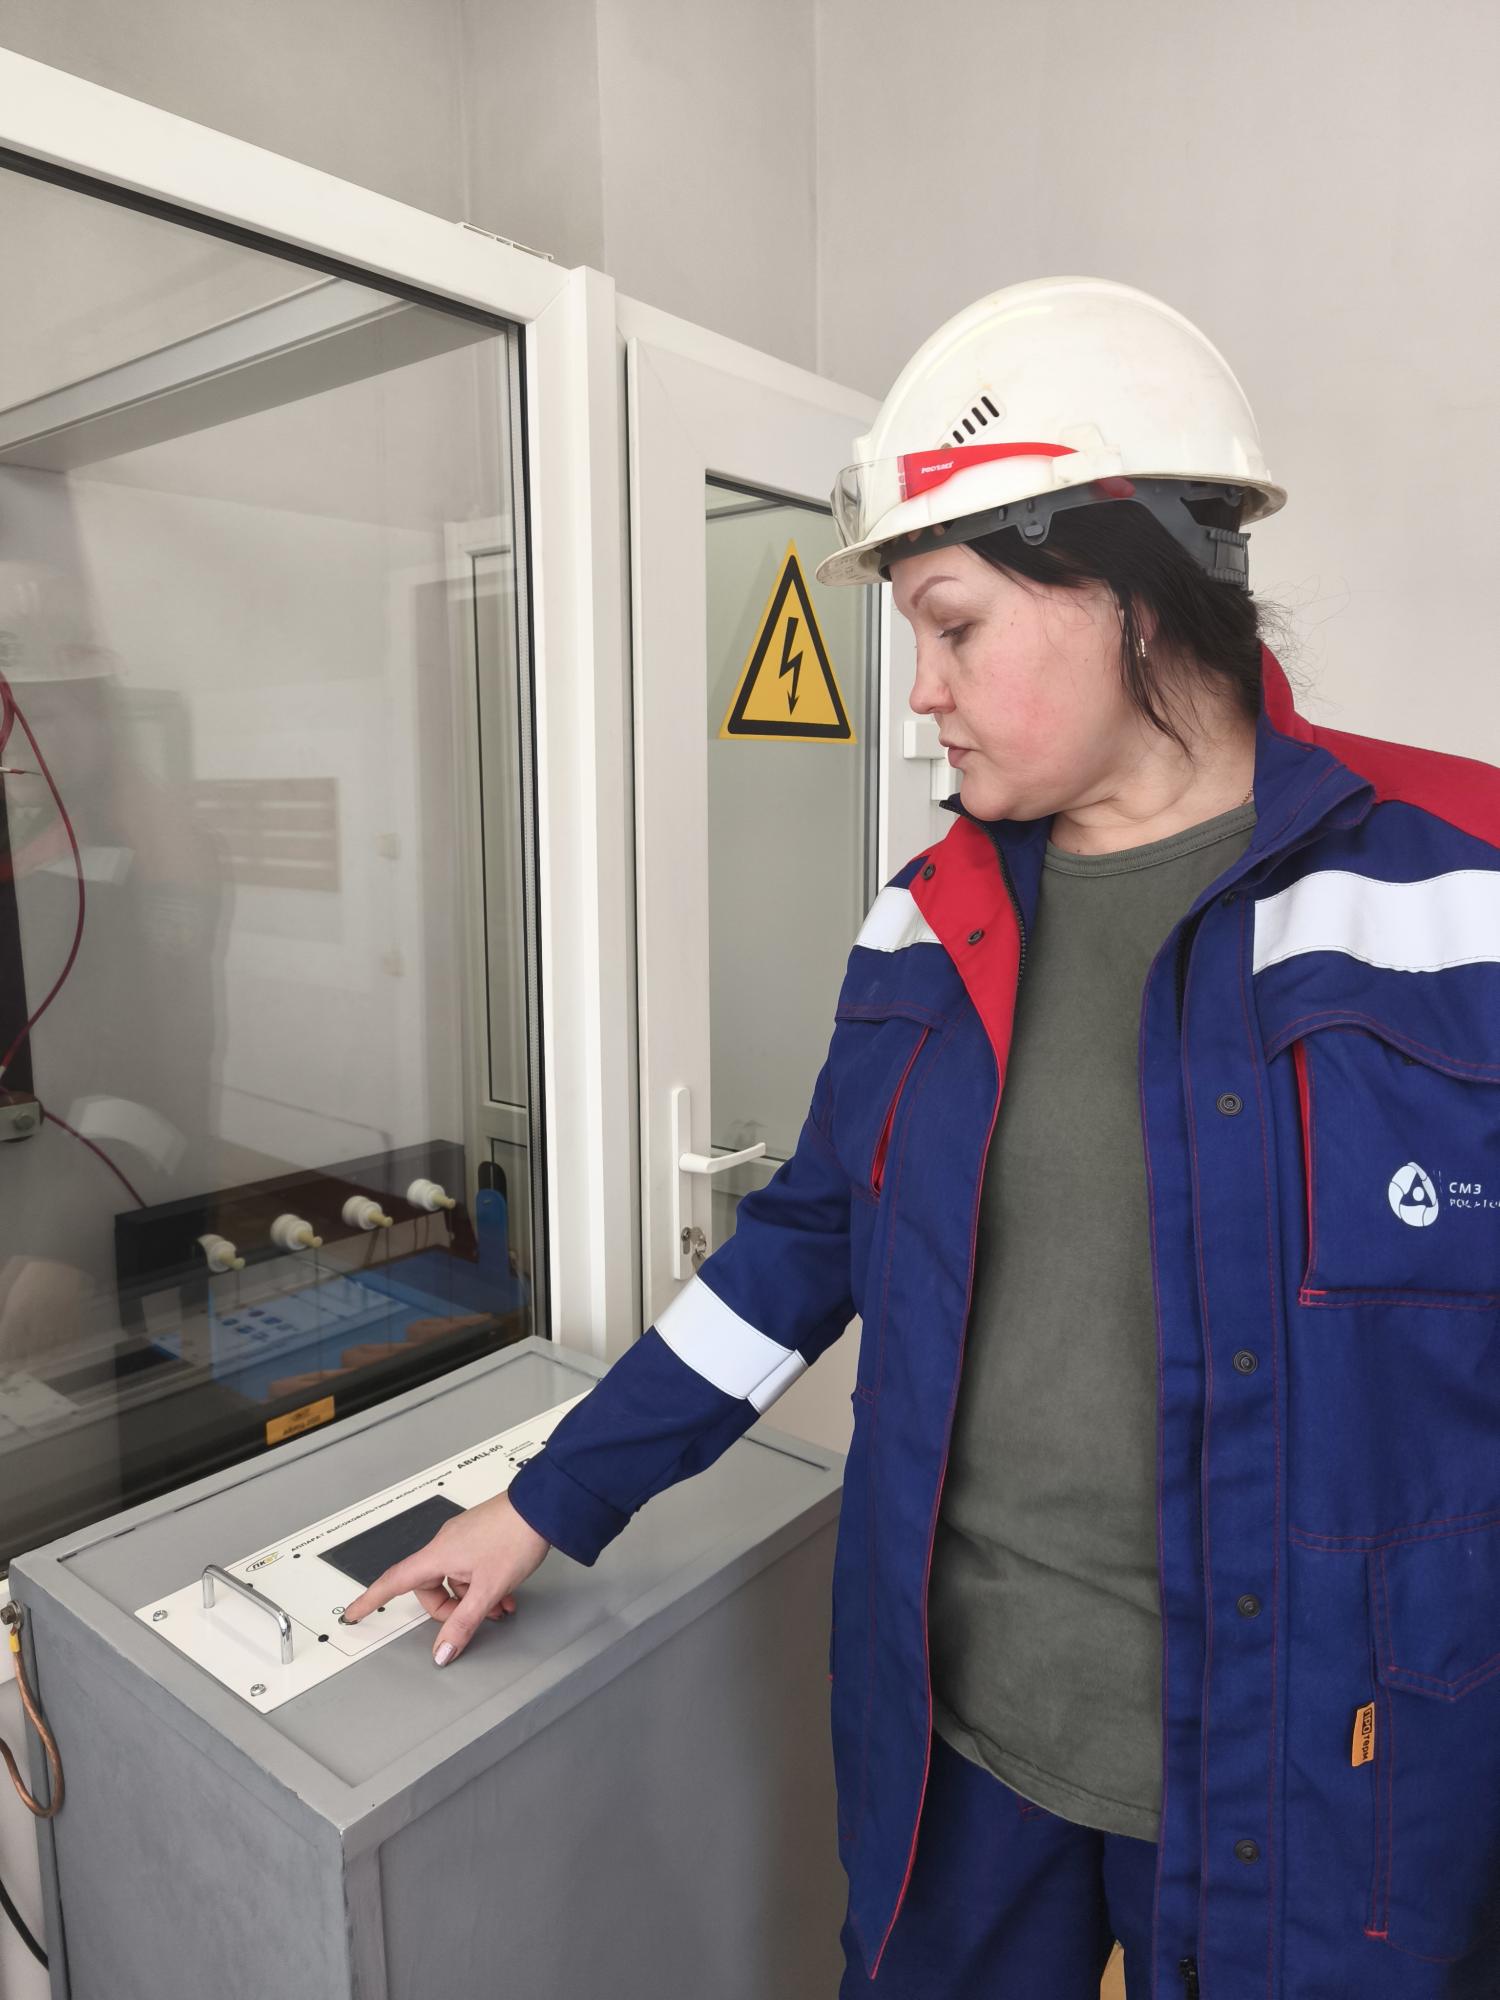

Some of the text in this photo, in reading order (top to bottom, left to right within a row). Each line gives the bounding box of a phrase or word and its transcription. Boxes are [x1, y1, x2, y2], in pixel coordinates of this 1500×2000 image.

[1449, 1182, 1482, 1195] СМЗ
[291, 1532, 325, 1552] АППАРАТ
[457, 1443, 504, 1469] АВИЦ-80
